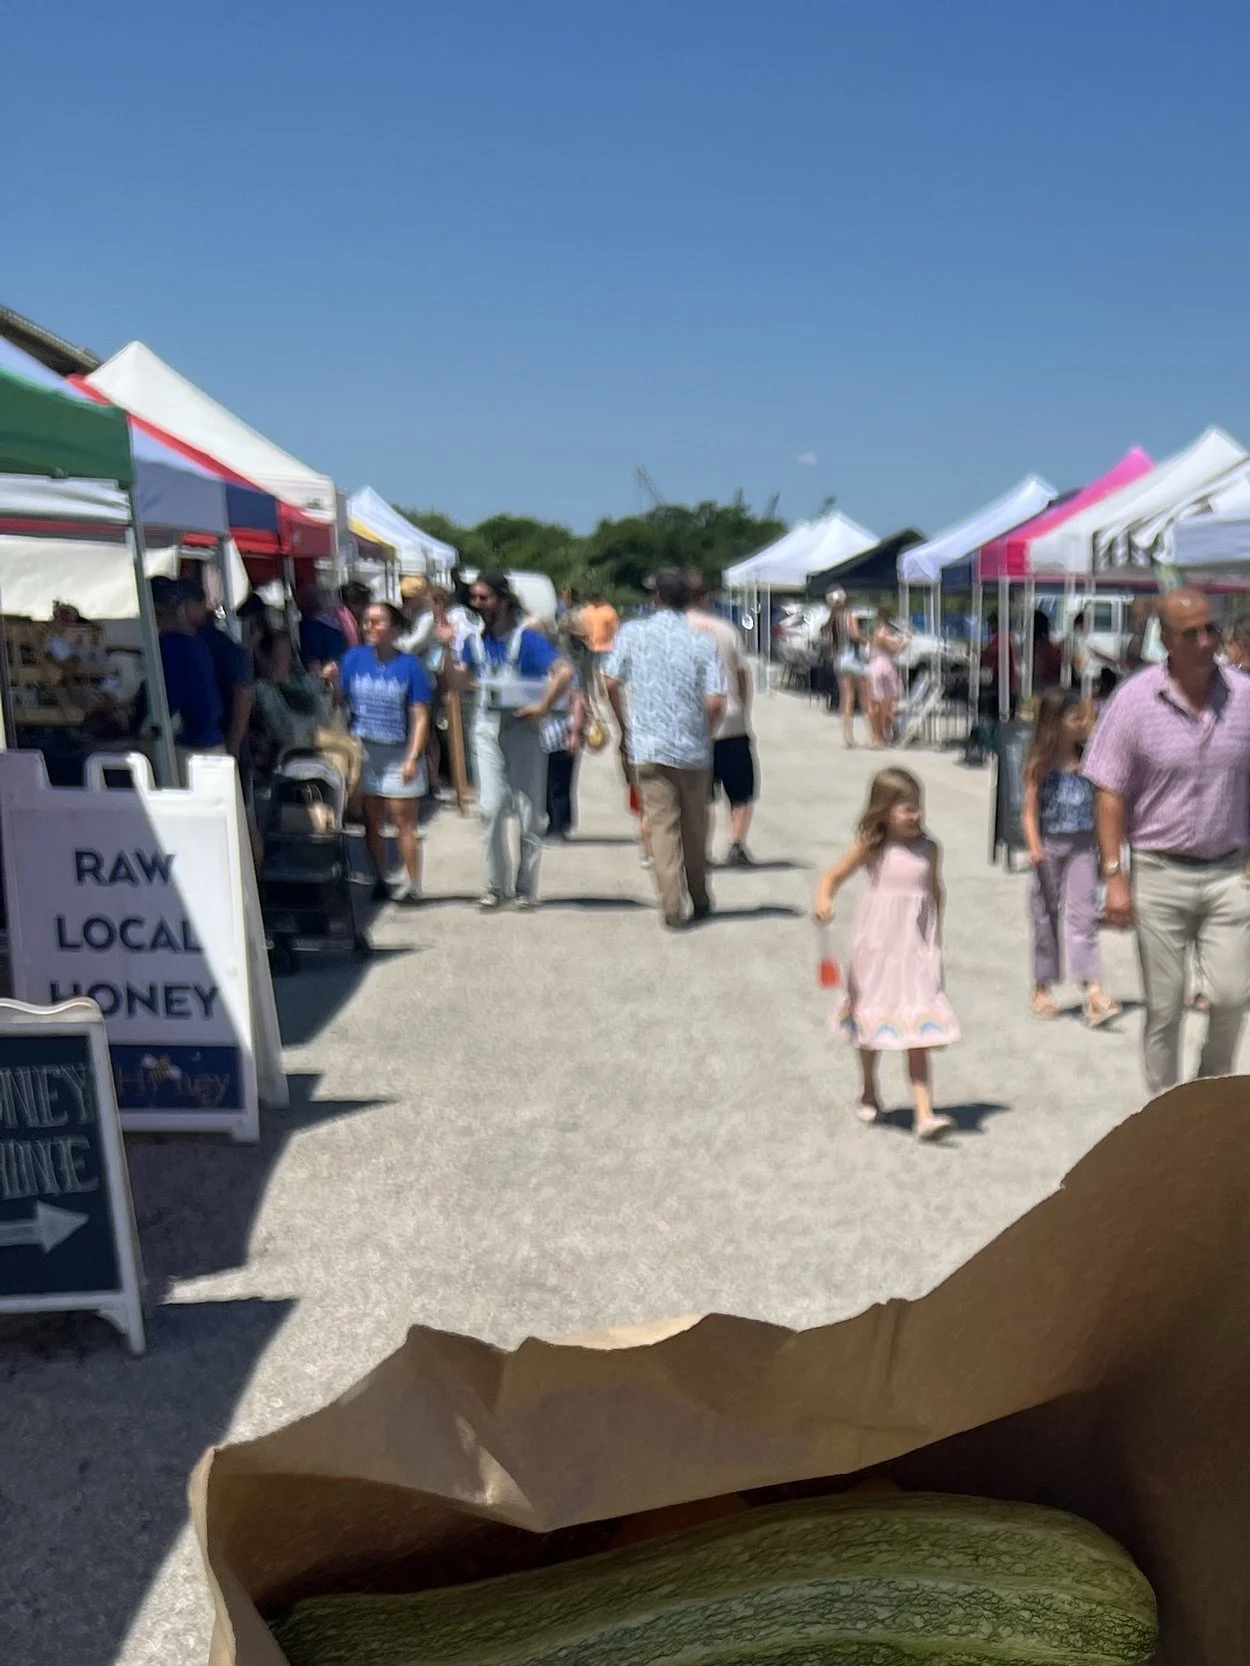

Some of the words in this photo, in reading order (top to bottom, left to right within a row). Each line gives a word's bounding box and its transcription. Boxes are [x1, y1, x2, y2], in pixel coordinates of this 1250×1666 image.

[74, 848, 176, 887] RAW
[55, 914, 206, 954] LOCAL
[0, 1062, 96, 1128] NEY
